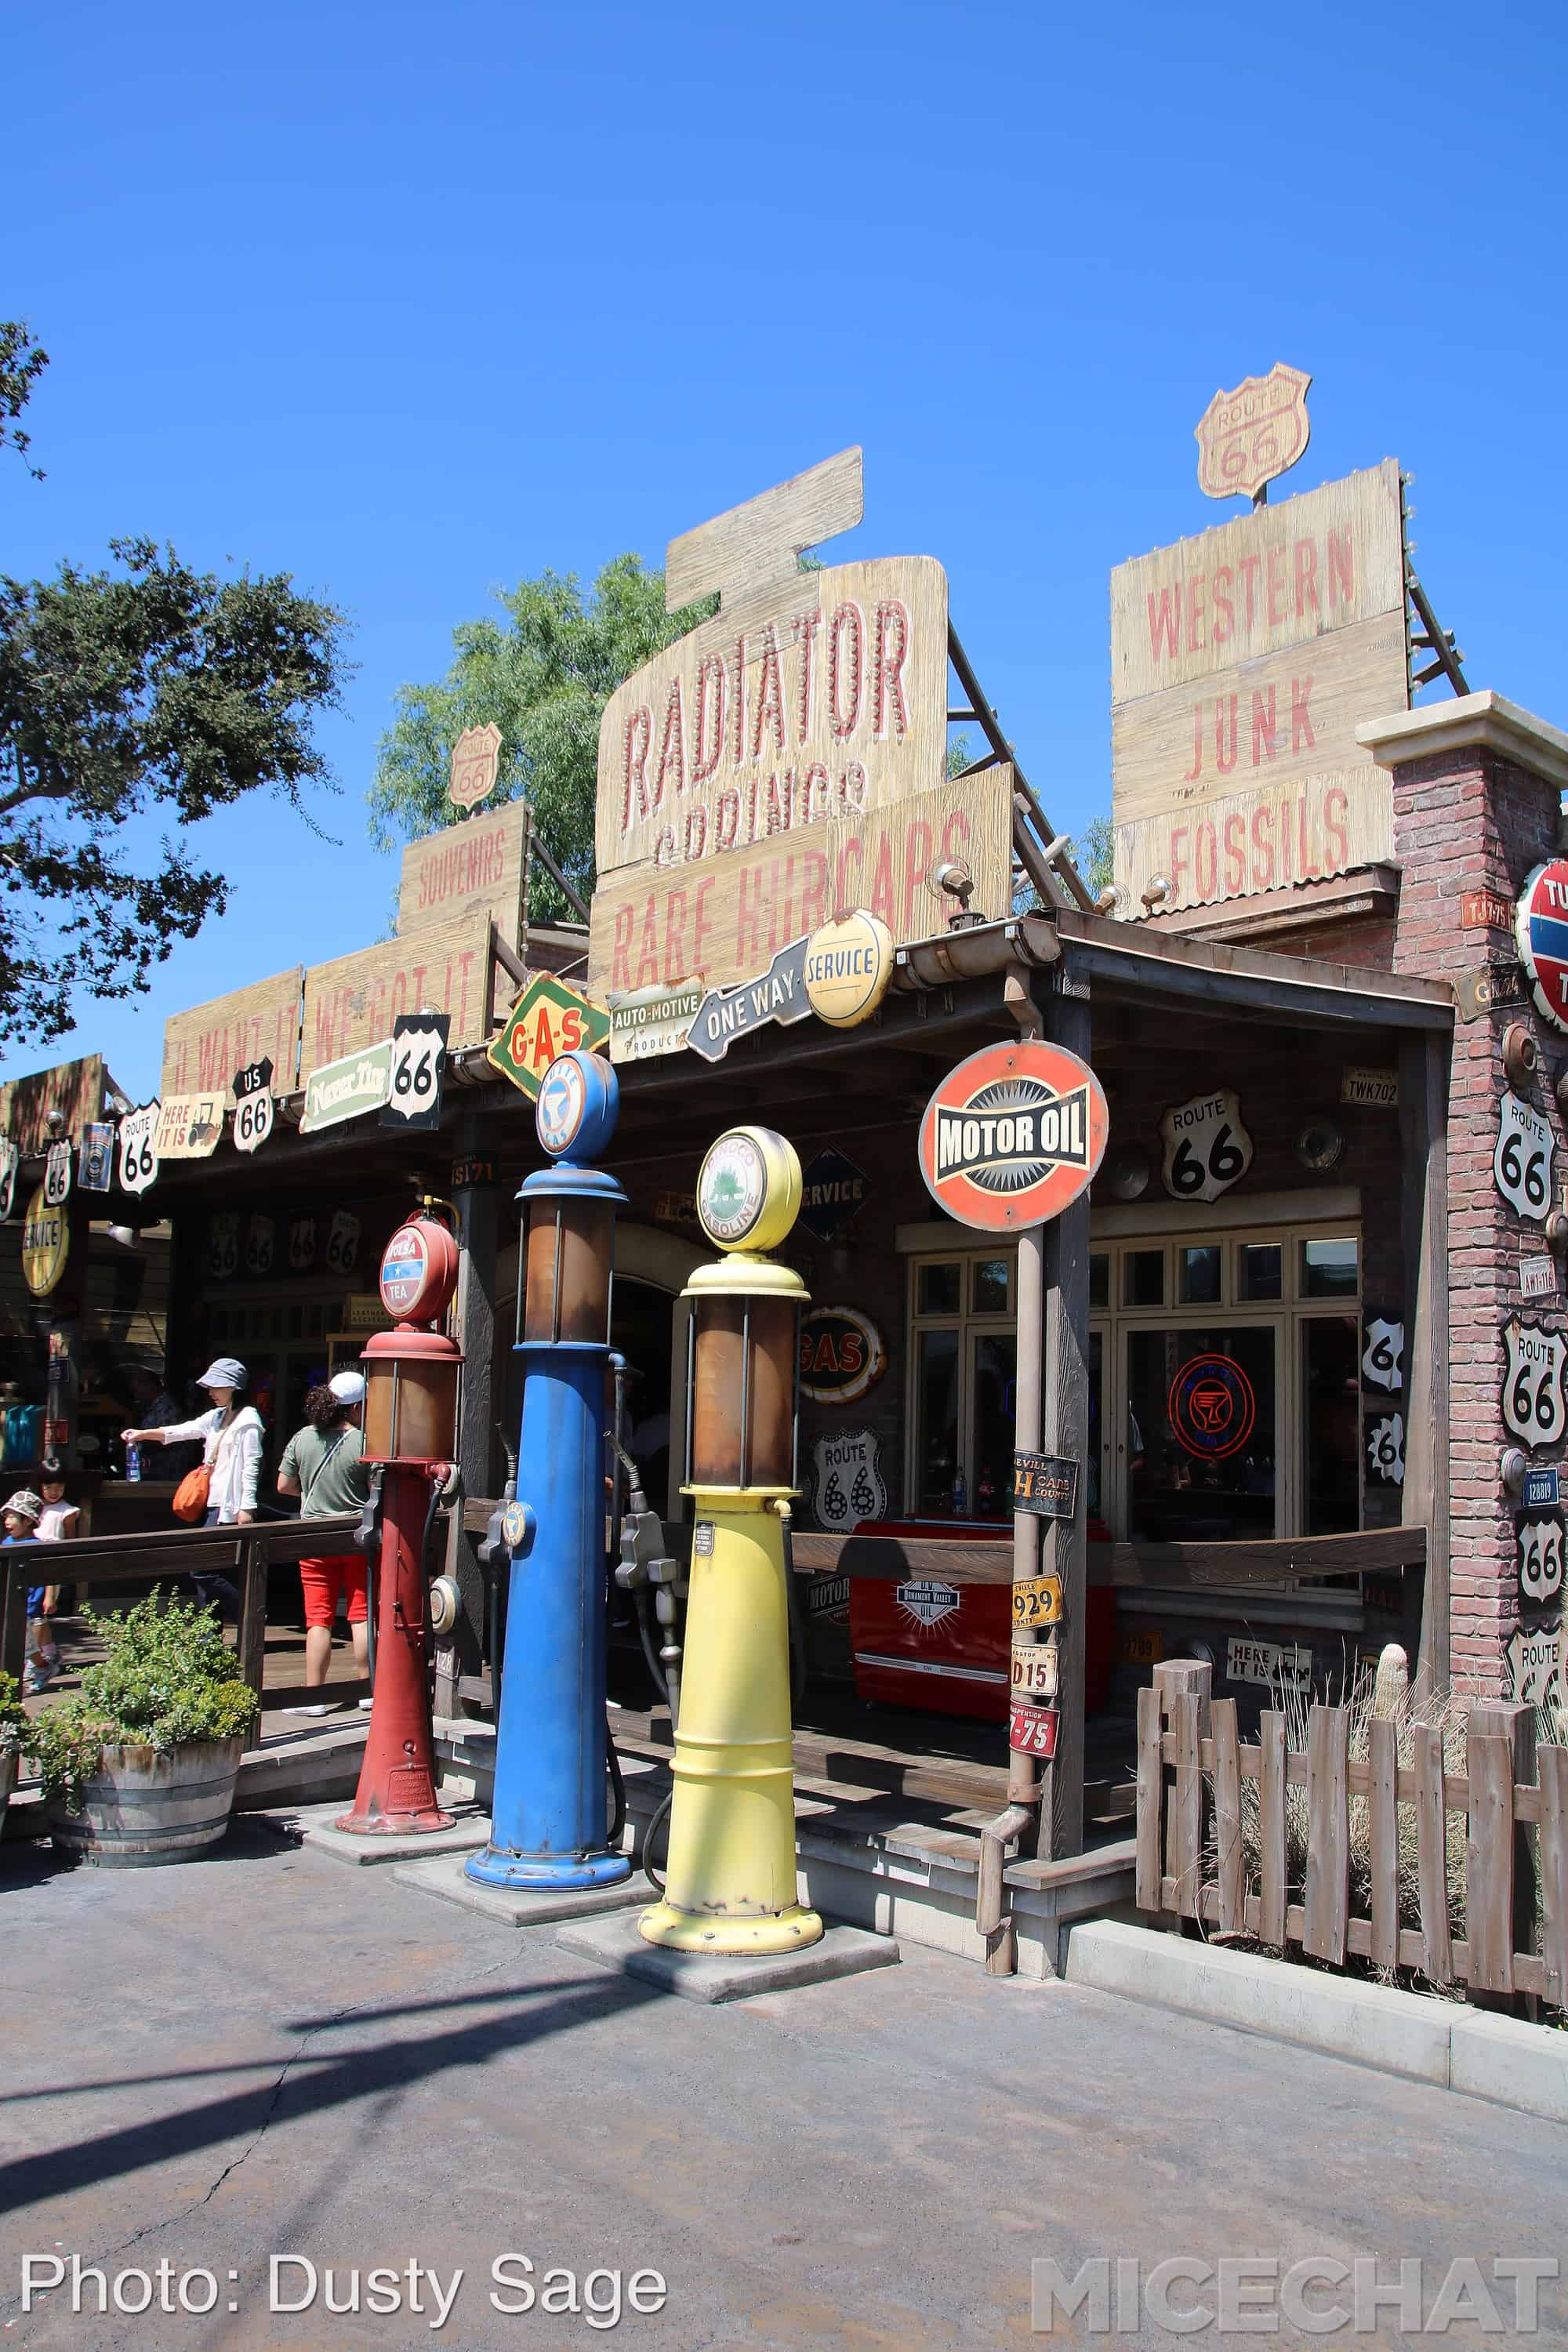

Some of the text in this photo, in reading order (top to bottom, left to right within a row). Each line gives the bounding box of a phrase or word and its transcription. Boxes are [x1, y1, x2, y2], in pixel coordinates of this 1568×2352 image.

[1218, 389, 1281, 430] ROUTE
[1219, 426, 1279, 481] 66
[1146, 524, 1355, 664] WESTERN
[619, 599, 910, 839] RADIATOR
[1184, 676, 1316, 781] JUNK
[464, 739, 488, 757] ROUTE
[459, 764, 485, 793] 66
[1169, 787, 1349, 903] FOSSILS
[611, 810, 972, 991] RARE HUBCAPS
[807, 946, 874, 983] SERVICE
[615, 995, 699, 1029] AUTO-MOTIVE
[708, 970, 797, 1041] ONE WAY
[244, 1069, 261, 1092] US
[394, 1048, 433, 1096] 66
[125, 1116, 151, 1138] ROUTE
[162, 1104, 190, 1126] HERE
[241, 1098, 267, 1140] 66
[1173, 1098, 1225, 1131] ROUTE
[1511, 1105, 1545, 1142] ROUTE
[158, 1127, 185, 1149] IT IS
[939, 1100, 1084, 1170] MOTOR OIL
[125, 1134, 153, 1182] 66
[1171, 1123, 1243, 1194] 66
[1501, 1133, 1545, 1207] 66
[49, 1169, 65, 1196] 66
[803, 1179, 863, 1206] ERVICE
[702, 1192, 759, 1236] GASOLINE
[389, 1285, 408, 1300] TEA
[800, 1332, 863, 1373] GAS
[1518, 1338, 1555, 1366] ROUTE
[1512, 1364, 1556, 1430] 66
[825, 1443, 867, 1468] ROUTE
[824, 1465, 876, 1521] 66
[1526, 1538, 1556, 1583] 66
[904, 1590, 951, 1604] ORNAMENT VALLEY
[920, 1605, 933, 1618] OIL
[1014, 1590, 1053, 1617] 929
[1233, 1664, 1269, 1678] IT IS
[1234, 1645, 1270, 1664] HERE
[1522, 1643, 1559, 1668] ROUTE
